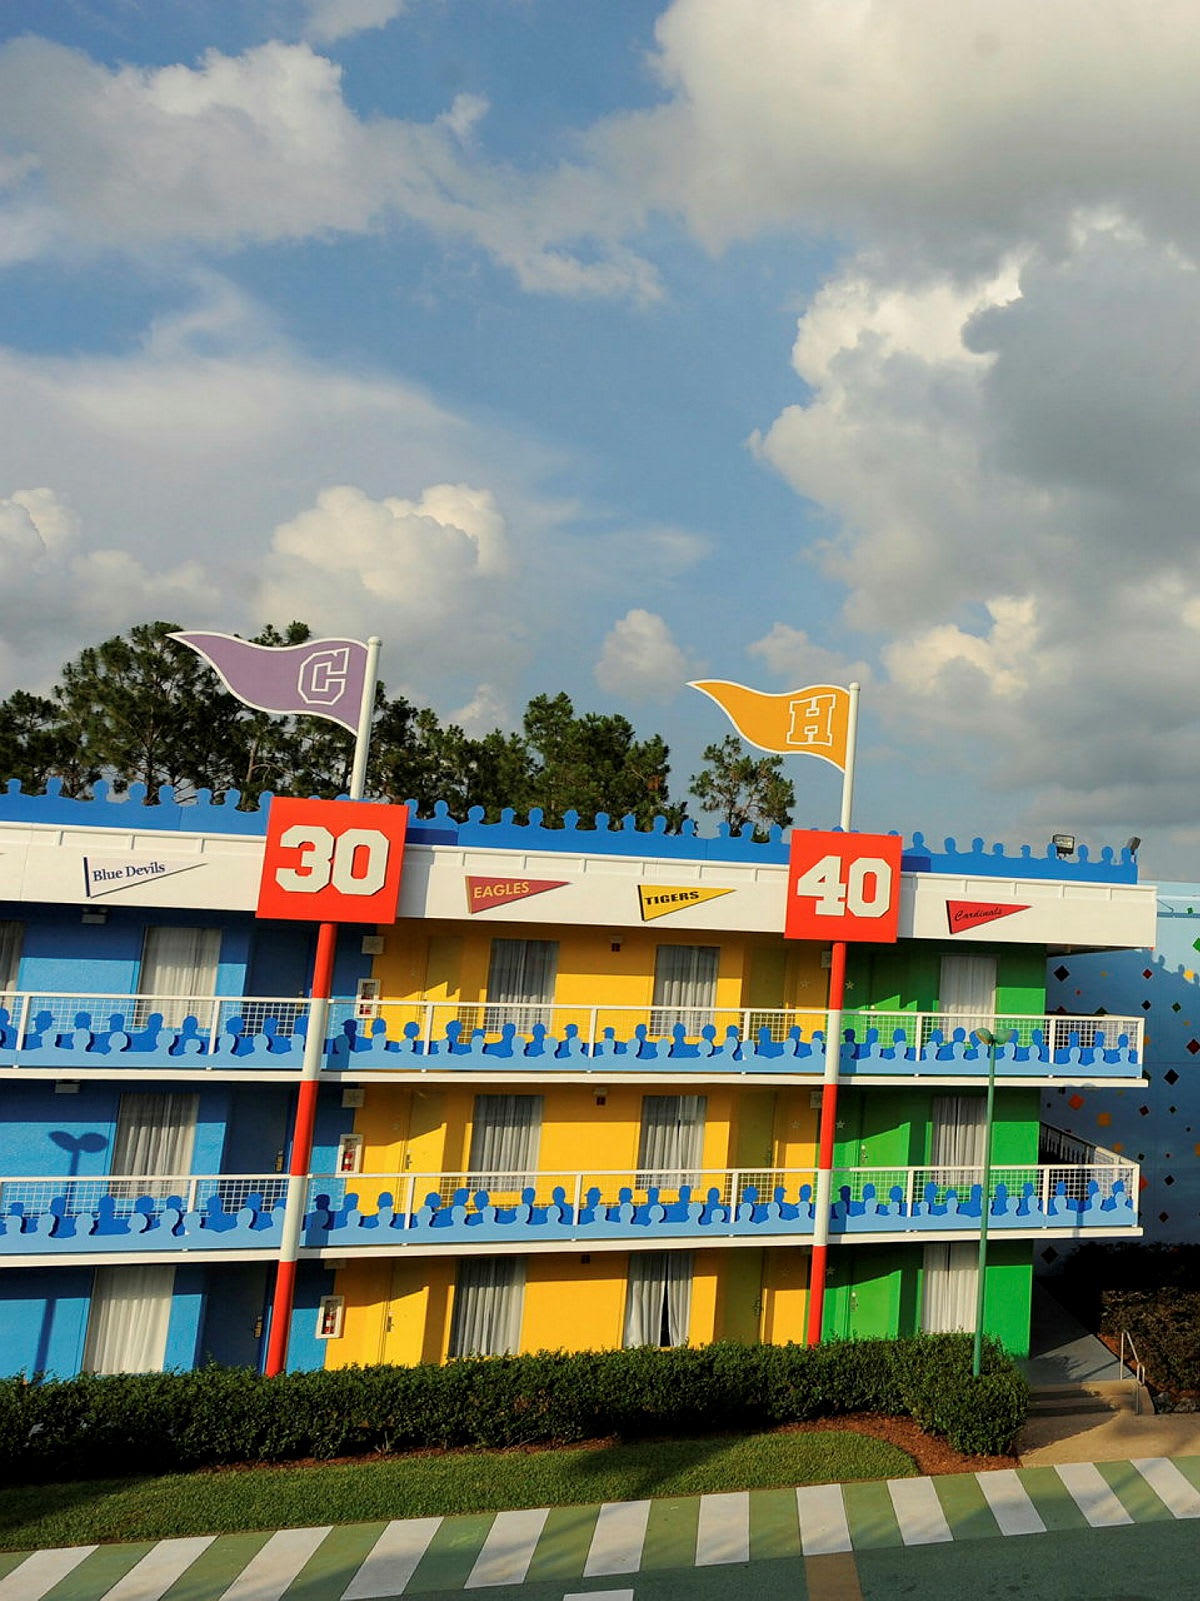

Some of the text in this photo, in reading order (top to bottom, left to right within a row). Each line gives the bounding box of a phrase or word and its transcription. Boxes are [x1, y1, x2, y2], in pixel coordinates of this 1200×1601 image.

[297, 647, 349, 705] C
[786, 693, 836, 746] H
[93, 861, 166, 883] Blue Devils
[275, 824, 390, 896] 30
[473, 881, 530, 899] EAGLES
[644, 890, 700, 906] TIGERS
[797, 855, 893, 919] 40
[954, 906, 1003, 922] Cardinals
